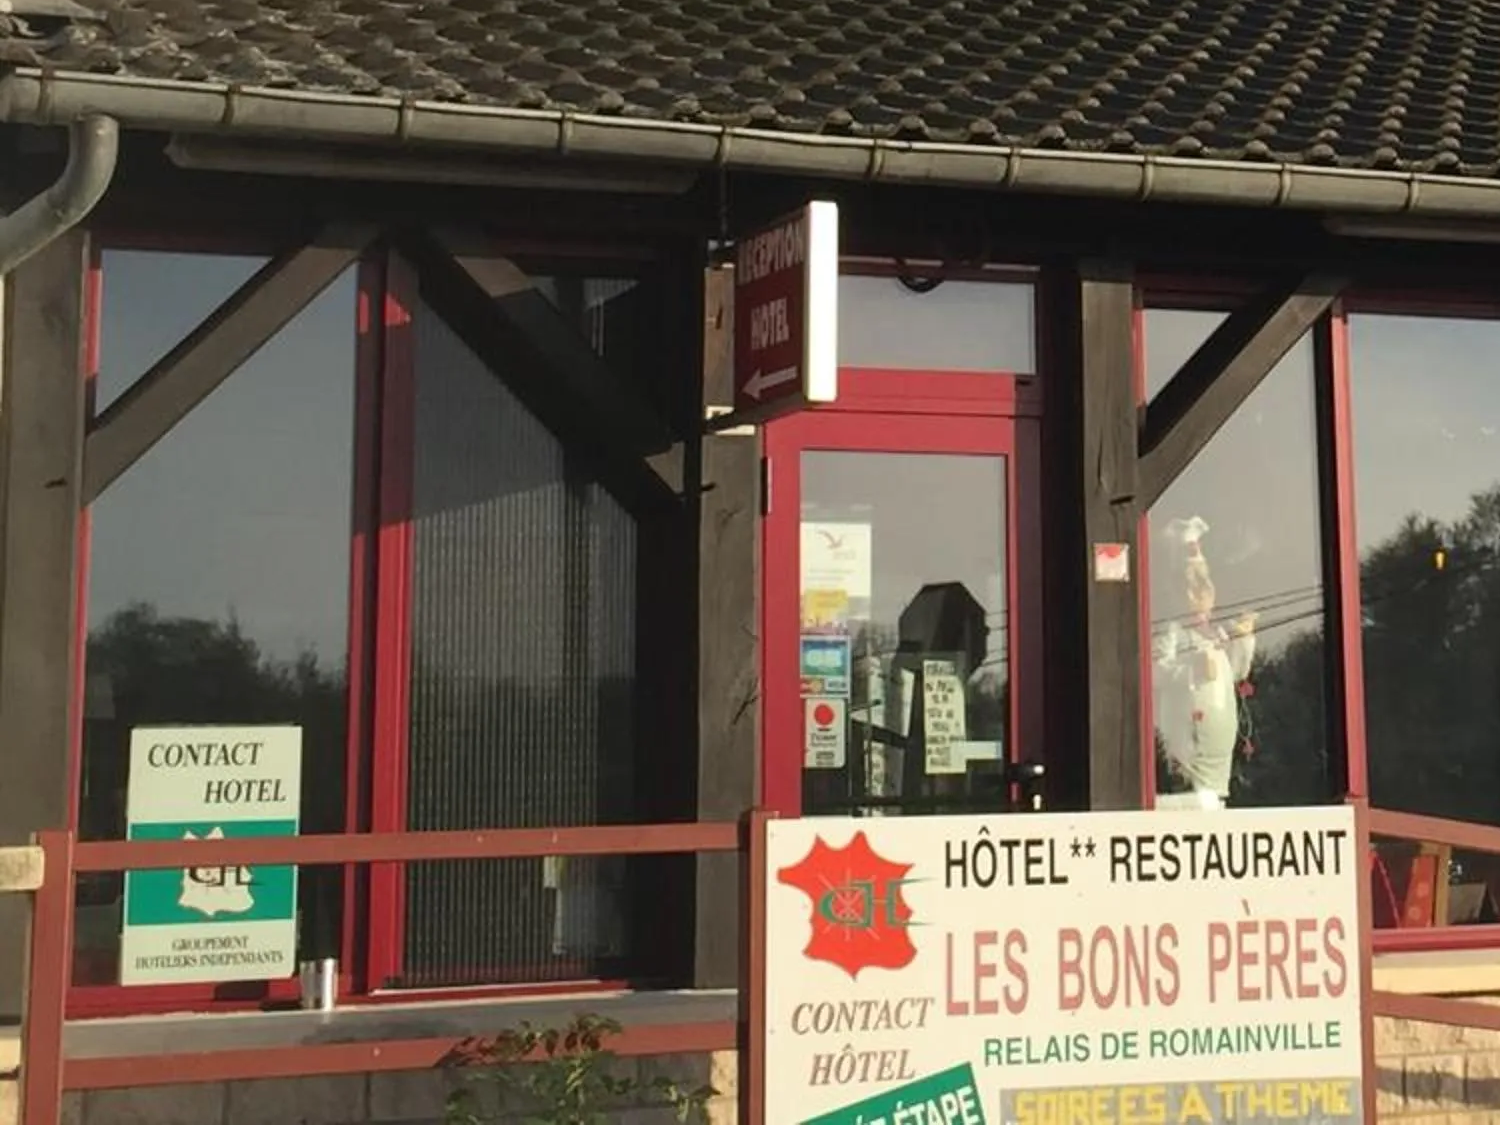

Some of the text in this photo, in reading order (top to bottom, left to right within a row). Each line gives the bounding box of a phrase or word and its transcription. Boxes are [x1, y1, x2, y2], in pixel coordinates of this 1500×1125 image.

[751, 296, 790, 350] HOTEL
[148, 742, 263, 768] CONTACT
[204, 778, 286, 804] HOTEL
[1110, 830, 1347, 882] RESTAURANT
[172, 935, 249, 952] GROUPEMENT
[946, 898, 1347, 1016] LES BONS PÈRES
[791, 997, 935, 1035] CONTACT
[809, 1042, 916, 1086] HÔTEL
[984, 1021, 1342, 1067] RELAIS DE ROMAINVILLE
